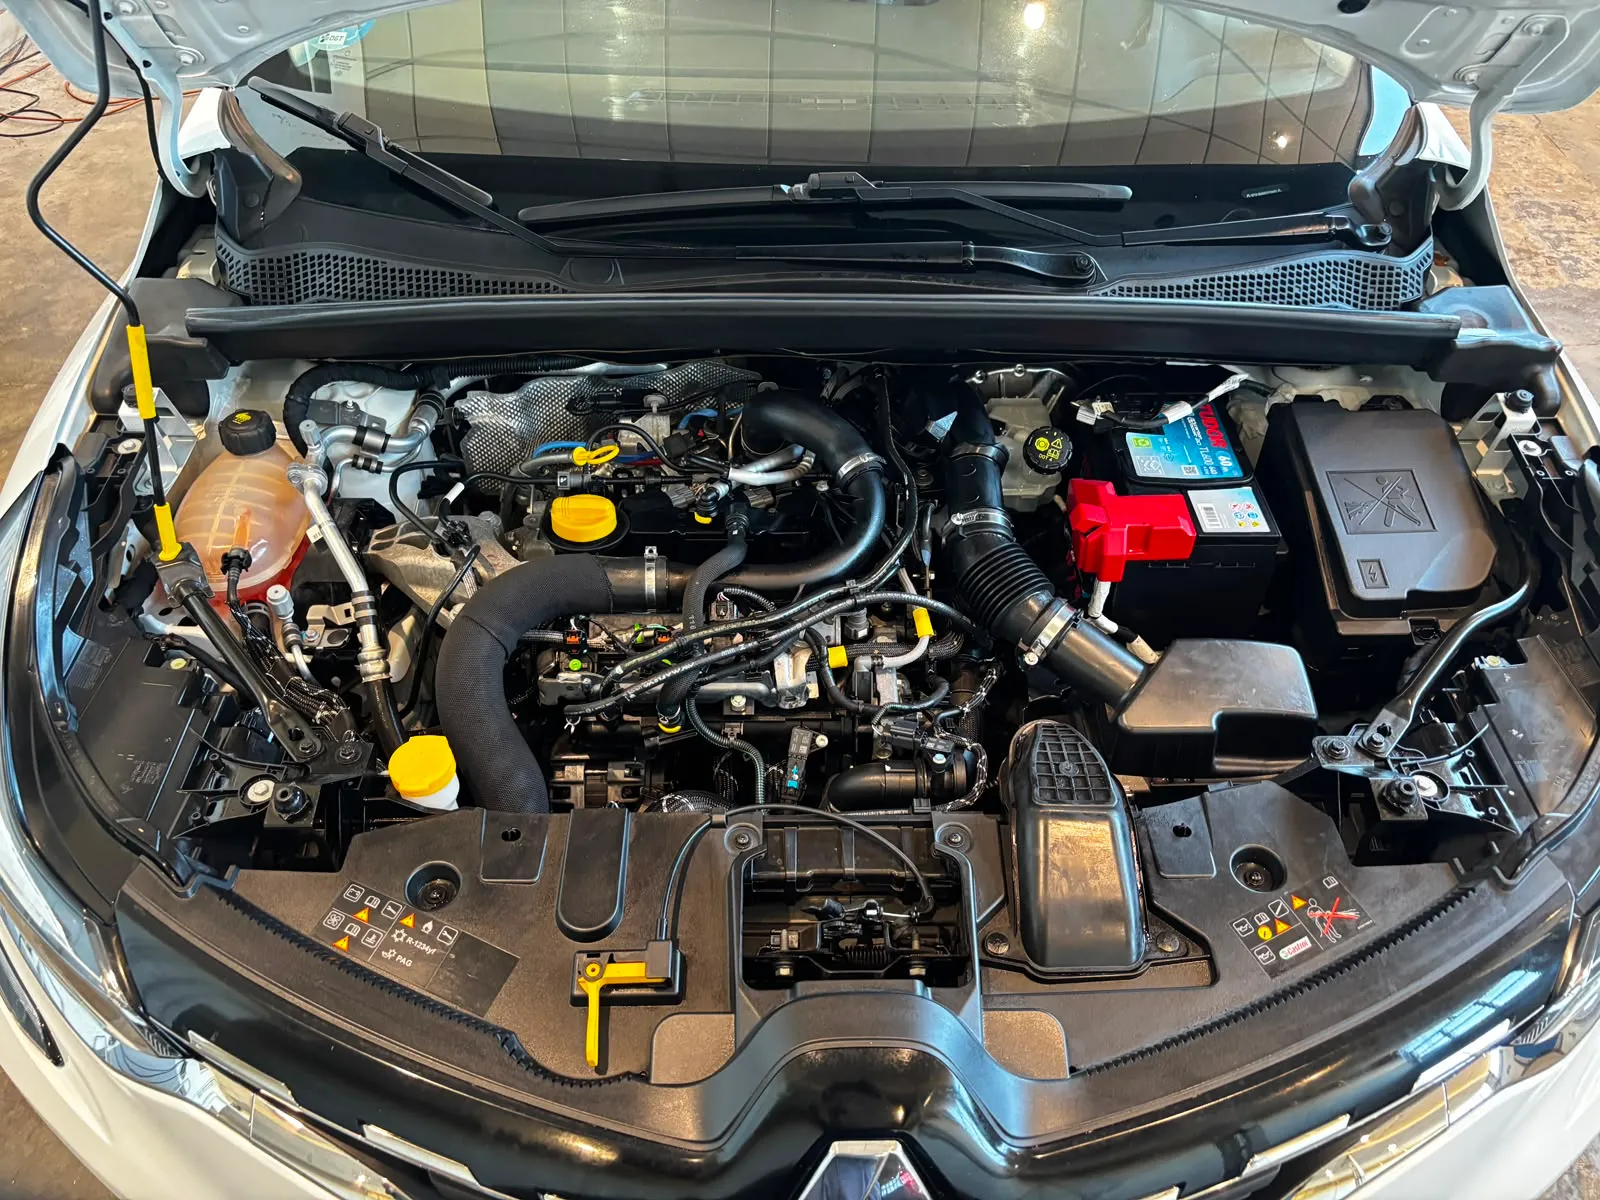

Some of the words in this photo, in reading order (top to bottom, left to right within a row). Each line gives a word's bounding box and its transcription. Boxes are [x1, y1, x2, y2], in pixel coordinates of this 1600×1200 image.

[1199, 404, 1228, 448] TUDOR
[406, 936, 437, 955] R-1234yf
[1287, 939, 1309, 956] Castrol
[395, 954, 413, 967] PAG
